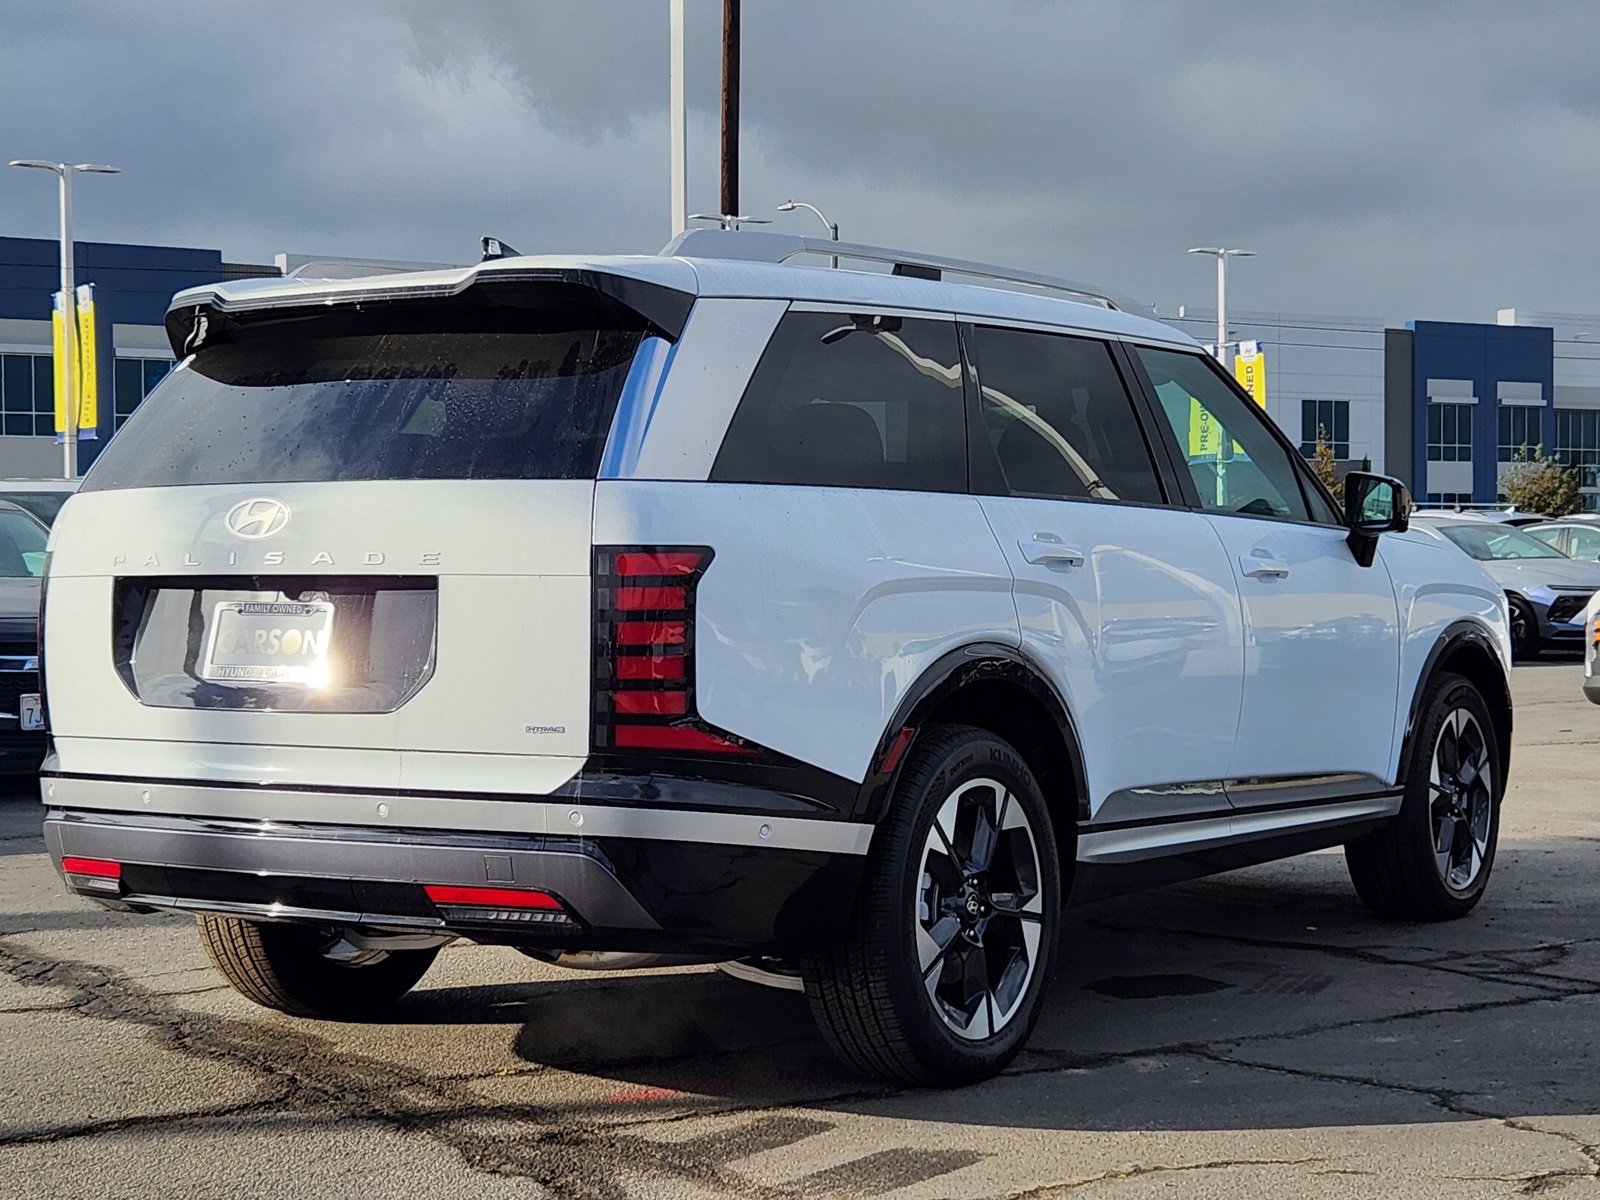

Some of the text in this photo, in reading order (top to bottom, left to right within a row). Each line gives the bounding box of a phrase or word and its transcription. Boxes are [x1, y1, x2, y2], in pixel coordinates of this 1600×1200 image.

[113, 551, 441, 567] PALISADE
[245, 603, 302, 613] FAMILY OWNED
[218, 629, 325, 655] CARSON
[989, 747, 1032, 786] KUMHO
